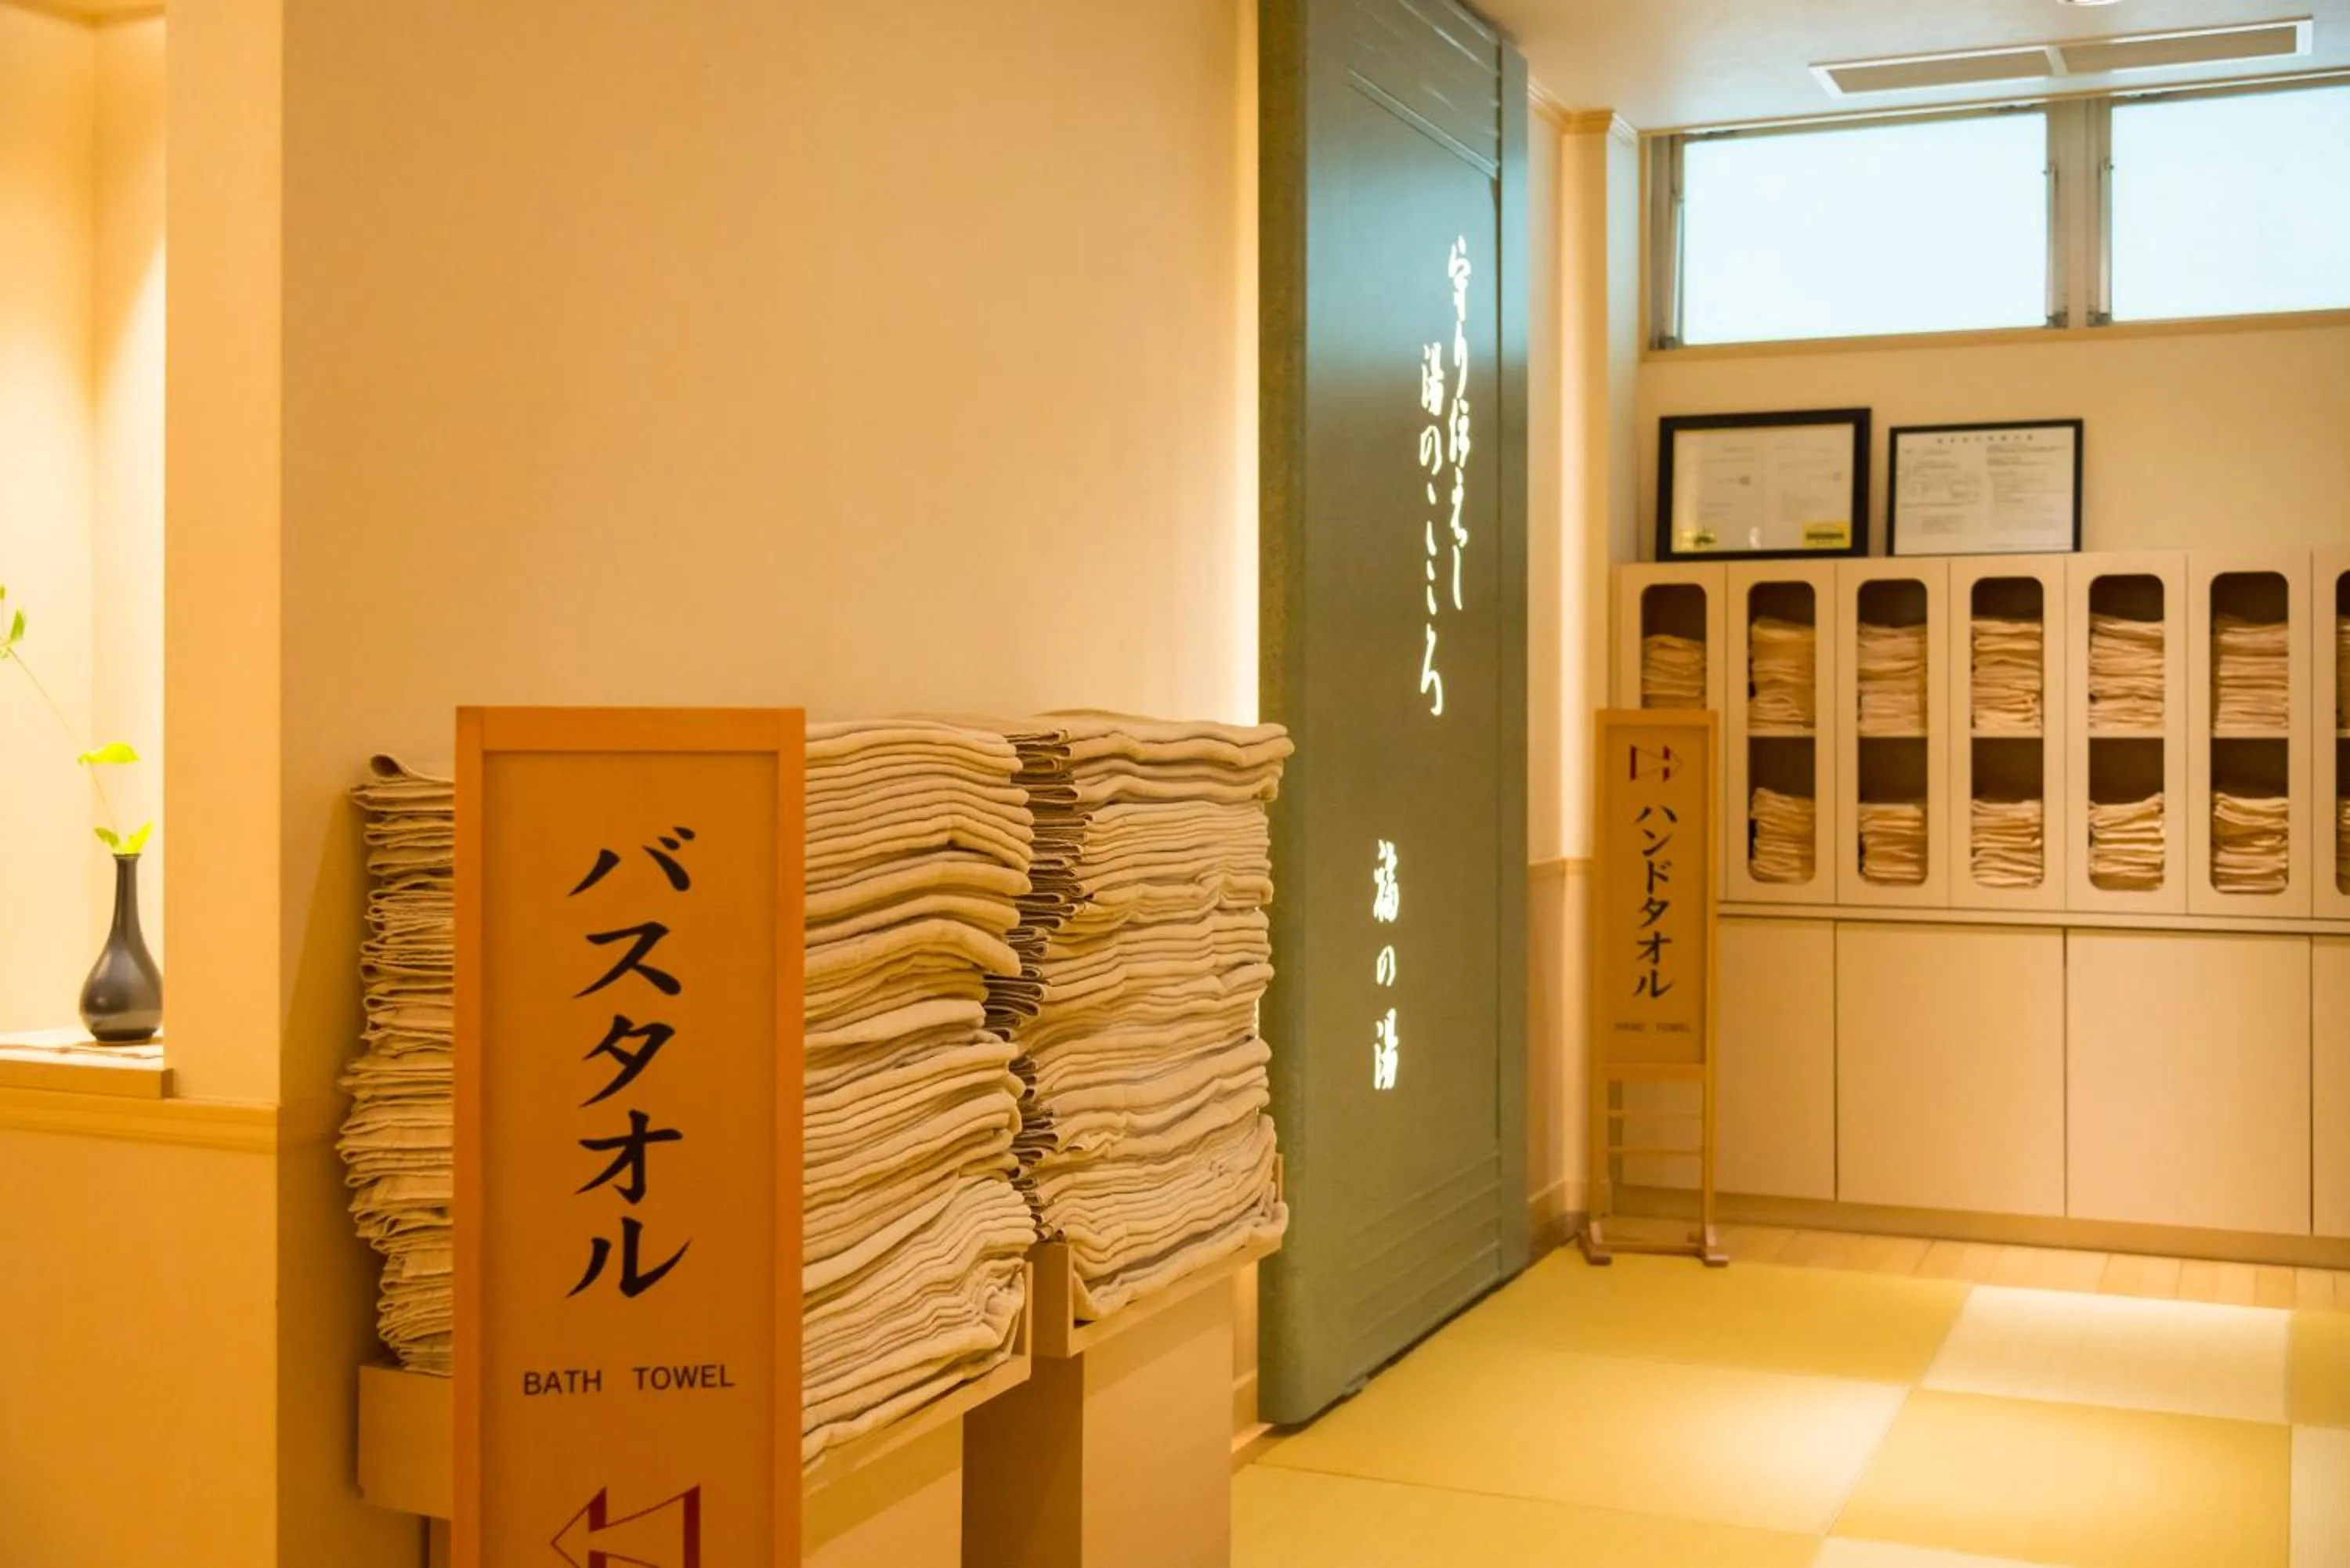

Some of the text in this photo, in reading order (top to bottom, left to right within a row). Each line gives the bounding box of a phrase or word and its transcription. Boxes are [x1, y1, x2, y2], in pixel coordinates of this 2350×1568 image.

[1632, 805, 1678, 999] ハンドタオル
[566, 826, 696, 1300] バスタオル
[524, 1364, 736, 1396] BATH TOWEL
